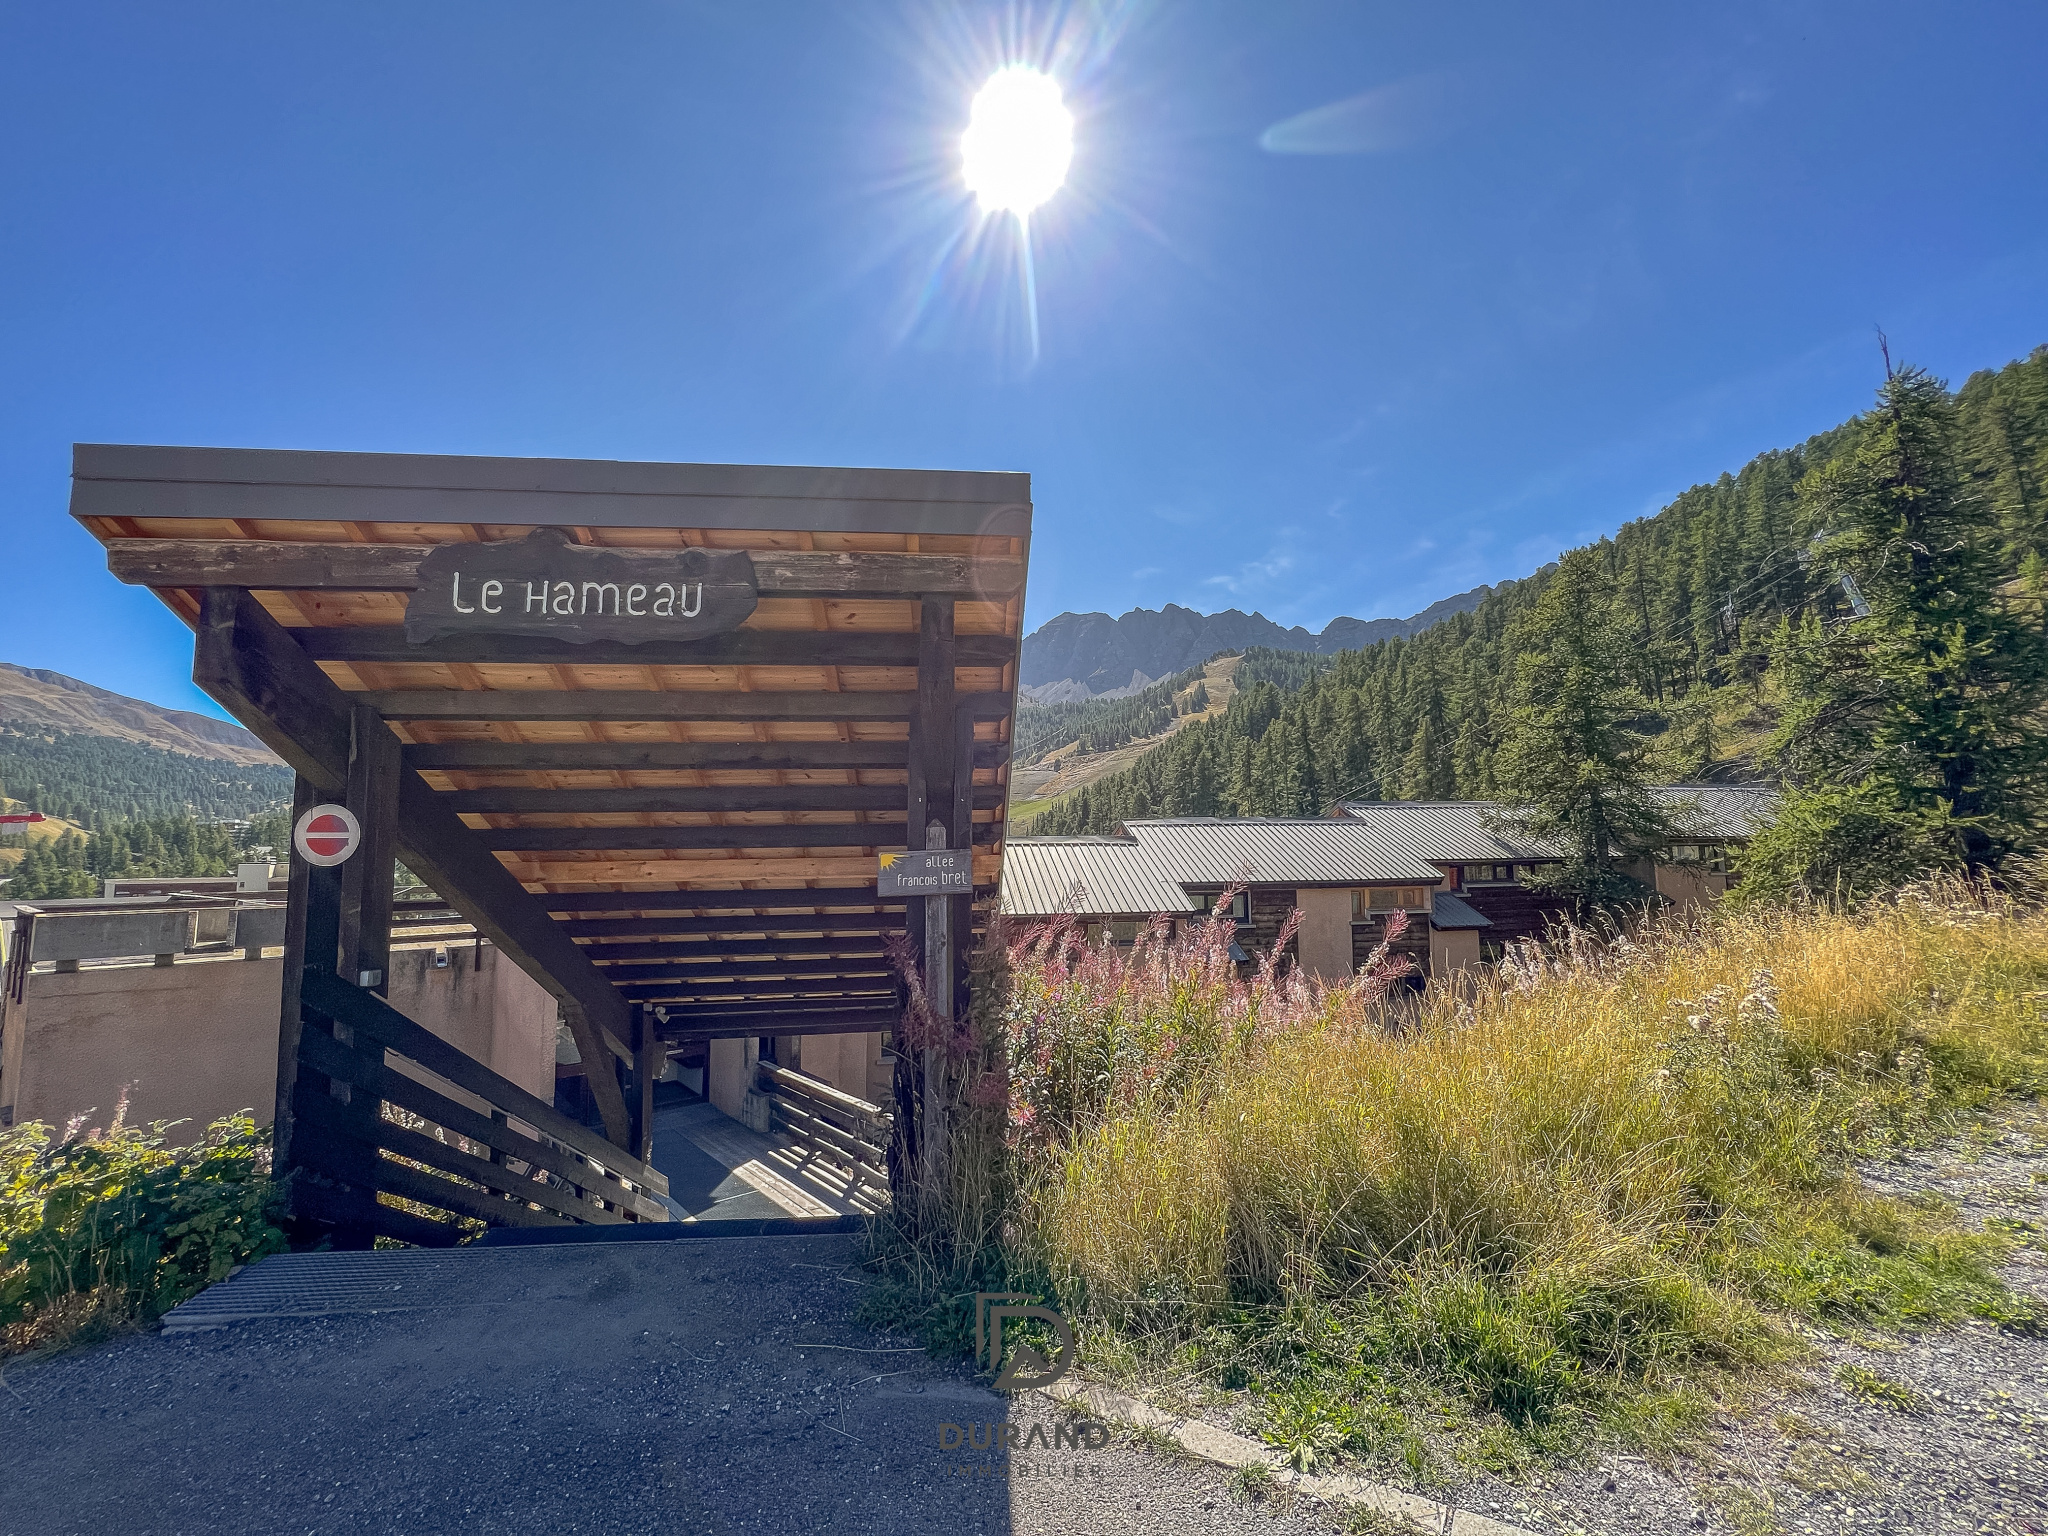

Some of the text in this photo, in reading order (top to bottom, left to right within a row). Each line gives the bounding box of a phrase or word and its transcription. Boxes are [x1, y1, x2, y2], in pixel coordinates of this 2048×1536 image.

[453, 571, 503, 613] Le
[926, 855, 954, 867] allee
[897, 870, 967, 886] francois bret
